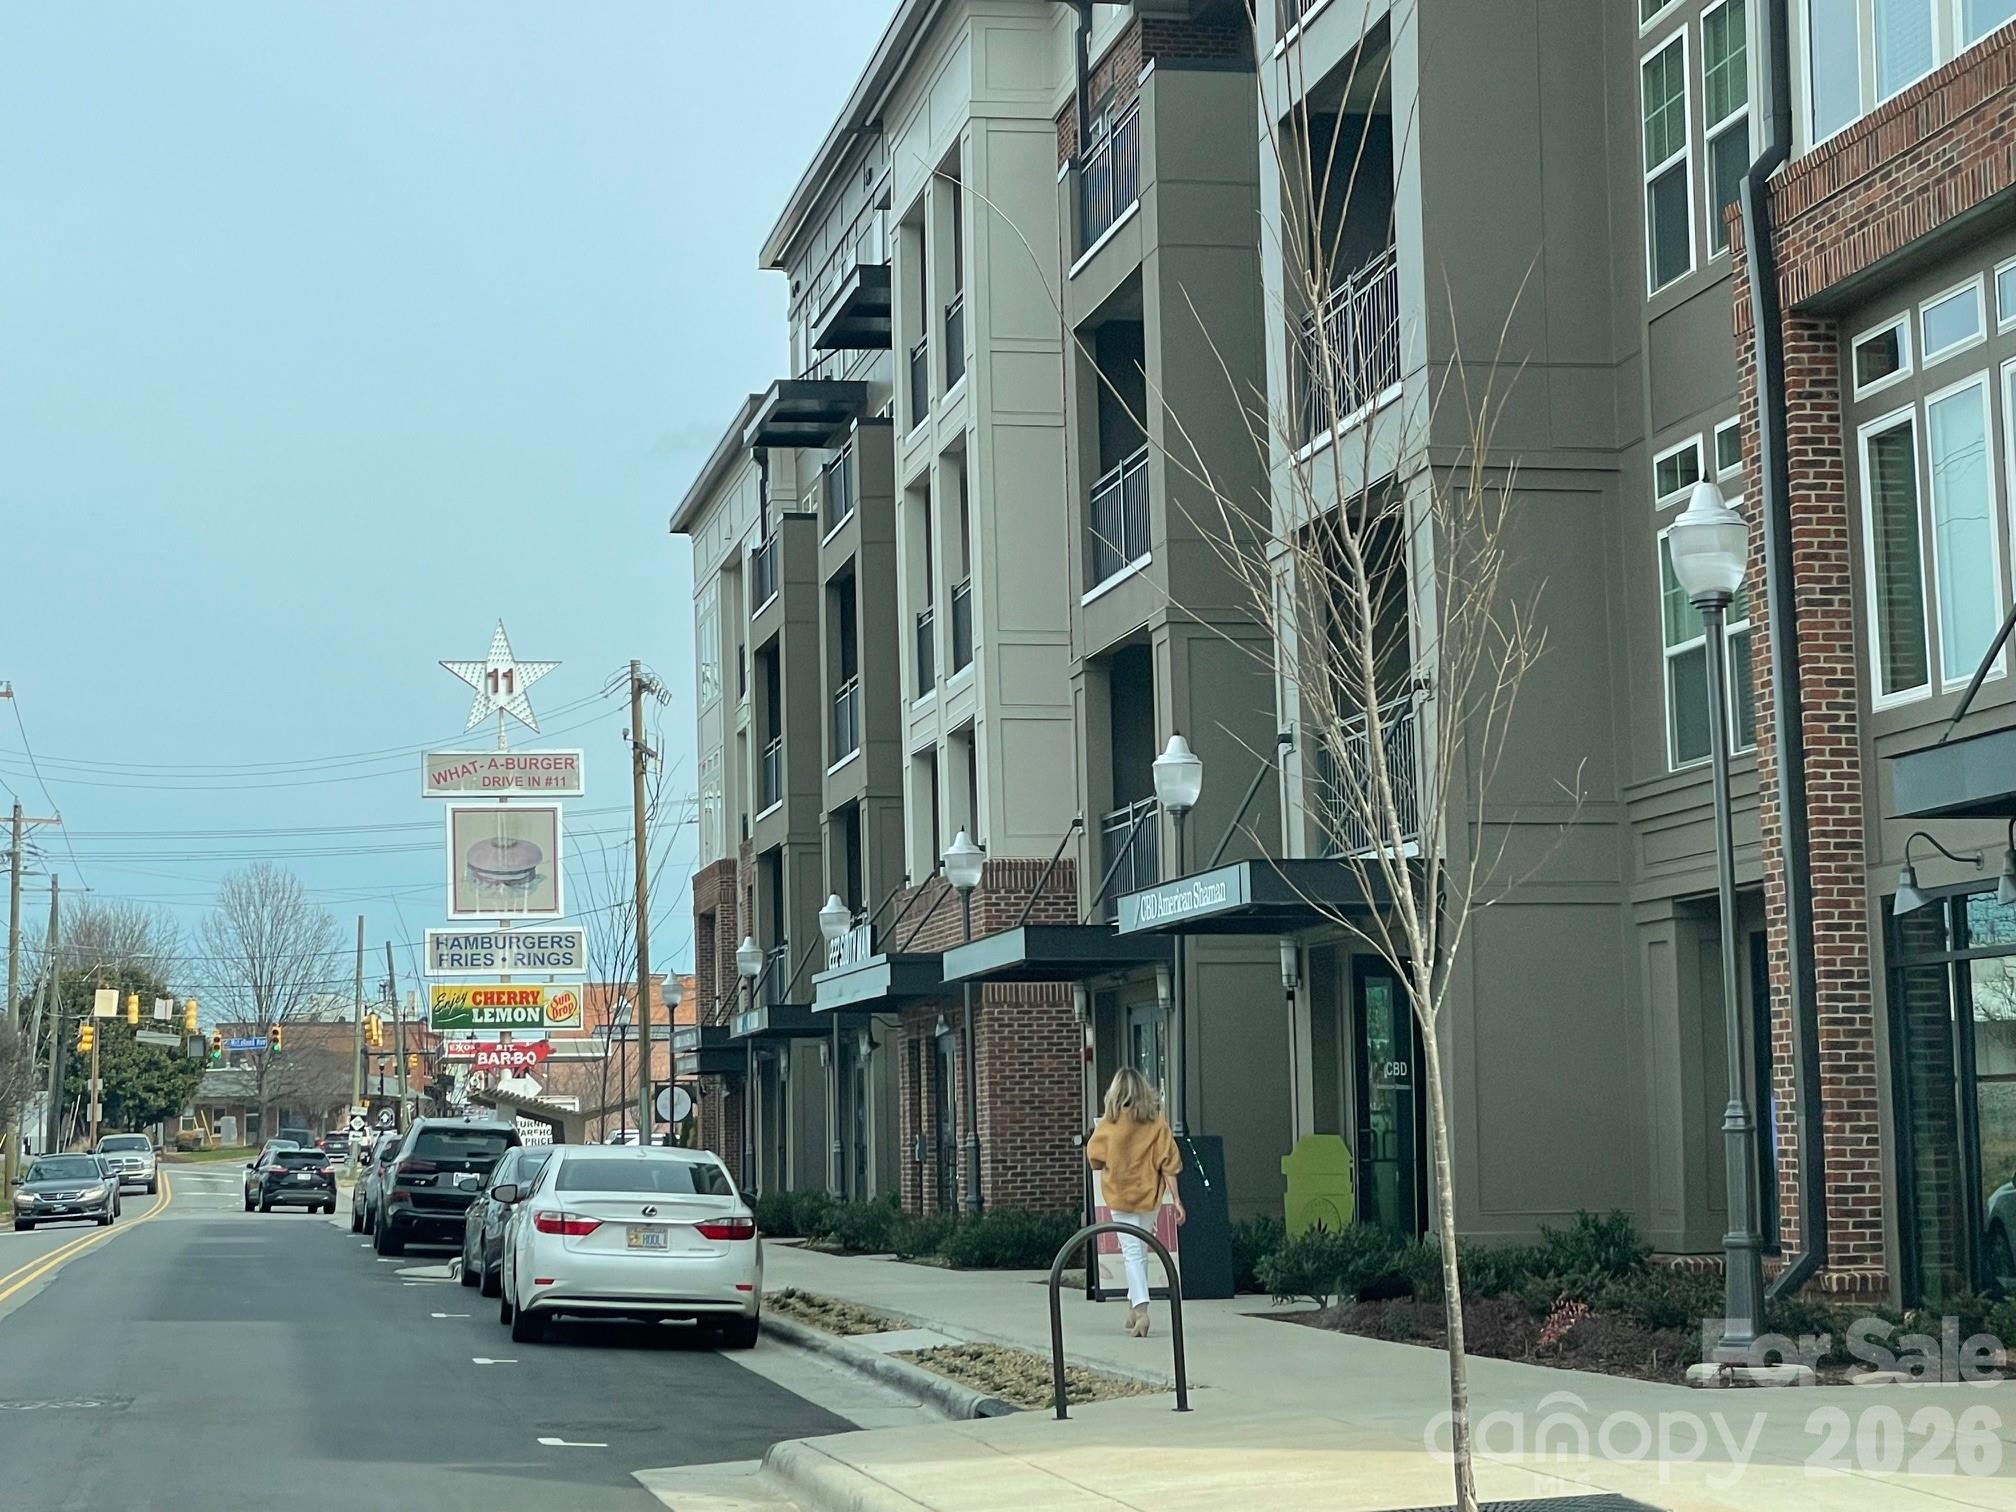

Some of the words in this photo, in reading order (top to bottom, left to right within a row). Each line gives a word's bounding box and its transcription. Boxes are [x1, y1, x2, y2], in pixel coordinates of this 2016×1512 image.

[487, 668, 513, 694] 11
[482, 776, 524, 787] DRIVE
[528, 776, 541, 787] IN
[545, 776, 566, 787] #11
[1140, 893, 1157, 922] CBD
[1158, 888, 1193, 917] American
[1193, 880, 1226, 910] Shaman
[436, 935, 576, 950] HAMBURGERS
[438, 953, 494, 967] FRIES
[514, 952, 574, 966] RINGS
[434, 991, 469, 1015] Enjoy
[472, 991, 540, 1005] CHERRY
[550, 992, 570, 1008] Sun
[472, 1008, 540, 1023] LEMON
[551, 1004, 574, 1020] Drop
[1386, 1061, 1407, 1076] CBD
